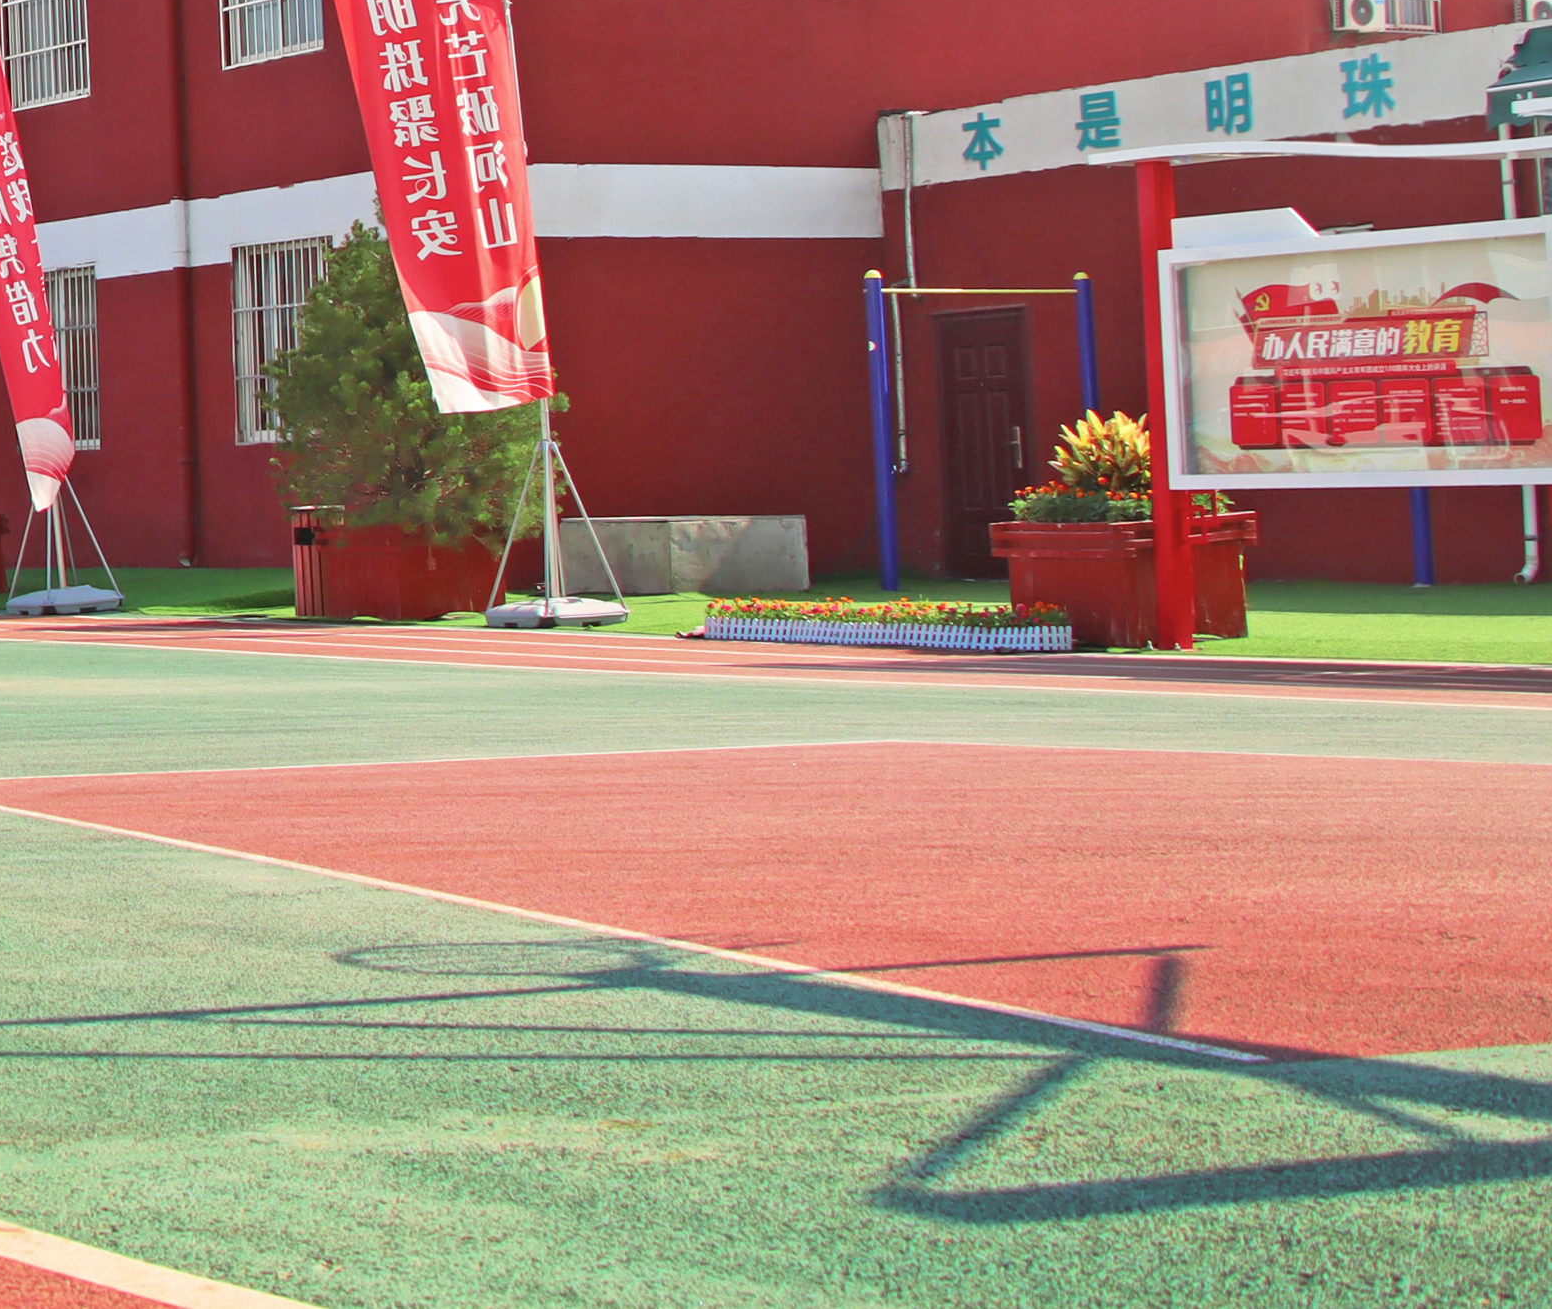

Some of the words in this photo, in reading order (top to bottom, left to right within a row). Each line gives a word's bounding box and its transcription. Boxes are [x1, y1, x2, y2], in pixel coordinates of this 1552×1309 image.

[962, 52, 1396, 171] 本是明珠
[1261, 318, 1463, 361] 办人民满意的教育
